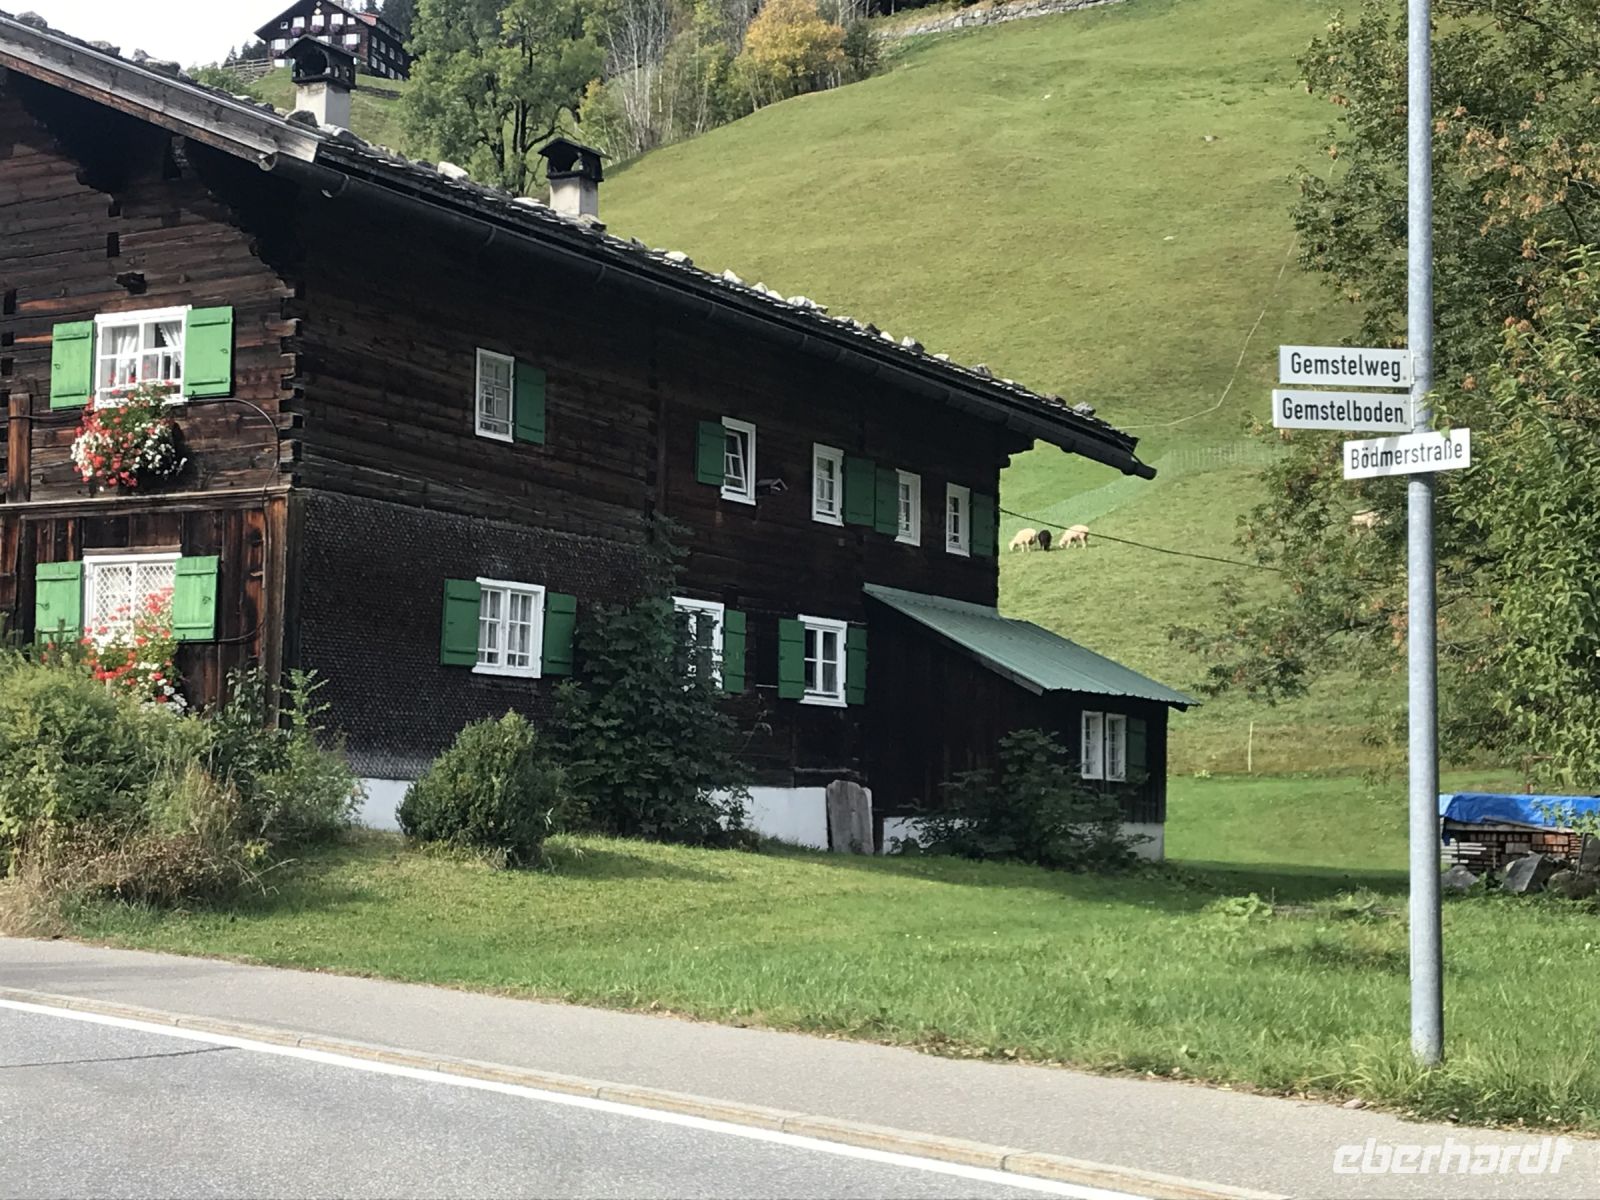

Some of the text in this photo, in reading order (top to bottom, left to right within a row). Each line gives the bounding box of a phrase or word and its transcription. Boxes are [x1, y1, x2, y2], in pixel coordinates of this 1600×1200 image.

[1291, 352, 1401, 382] Gemstelweg
[1282, 397, 1404, 423] Gemstelboden
[1351, 440, 1463, 470] Bödmerstraße
